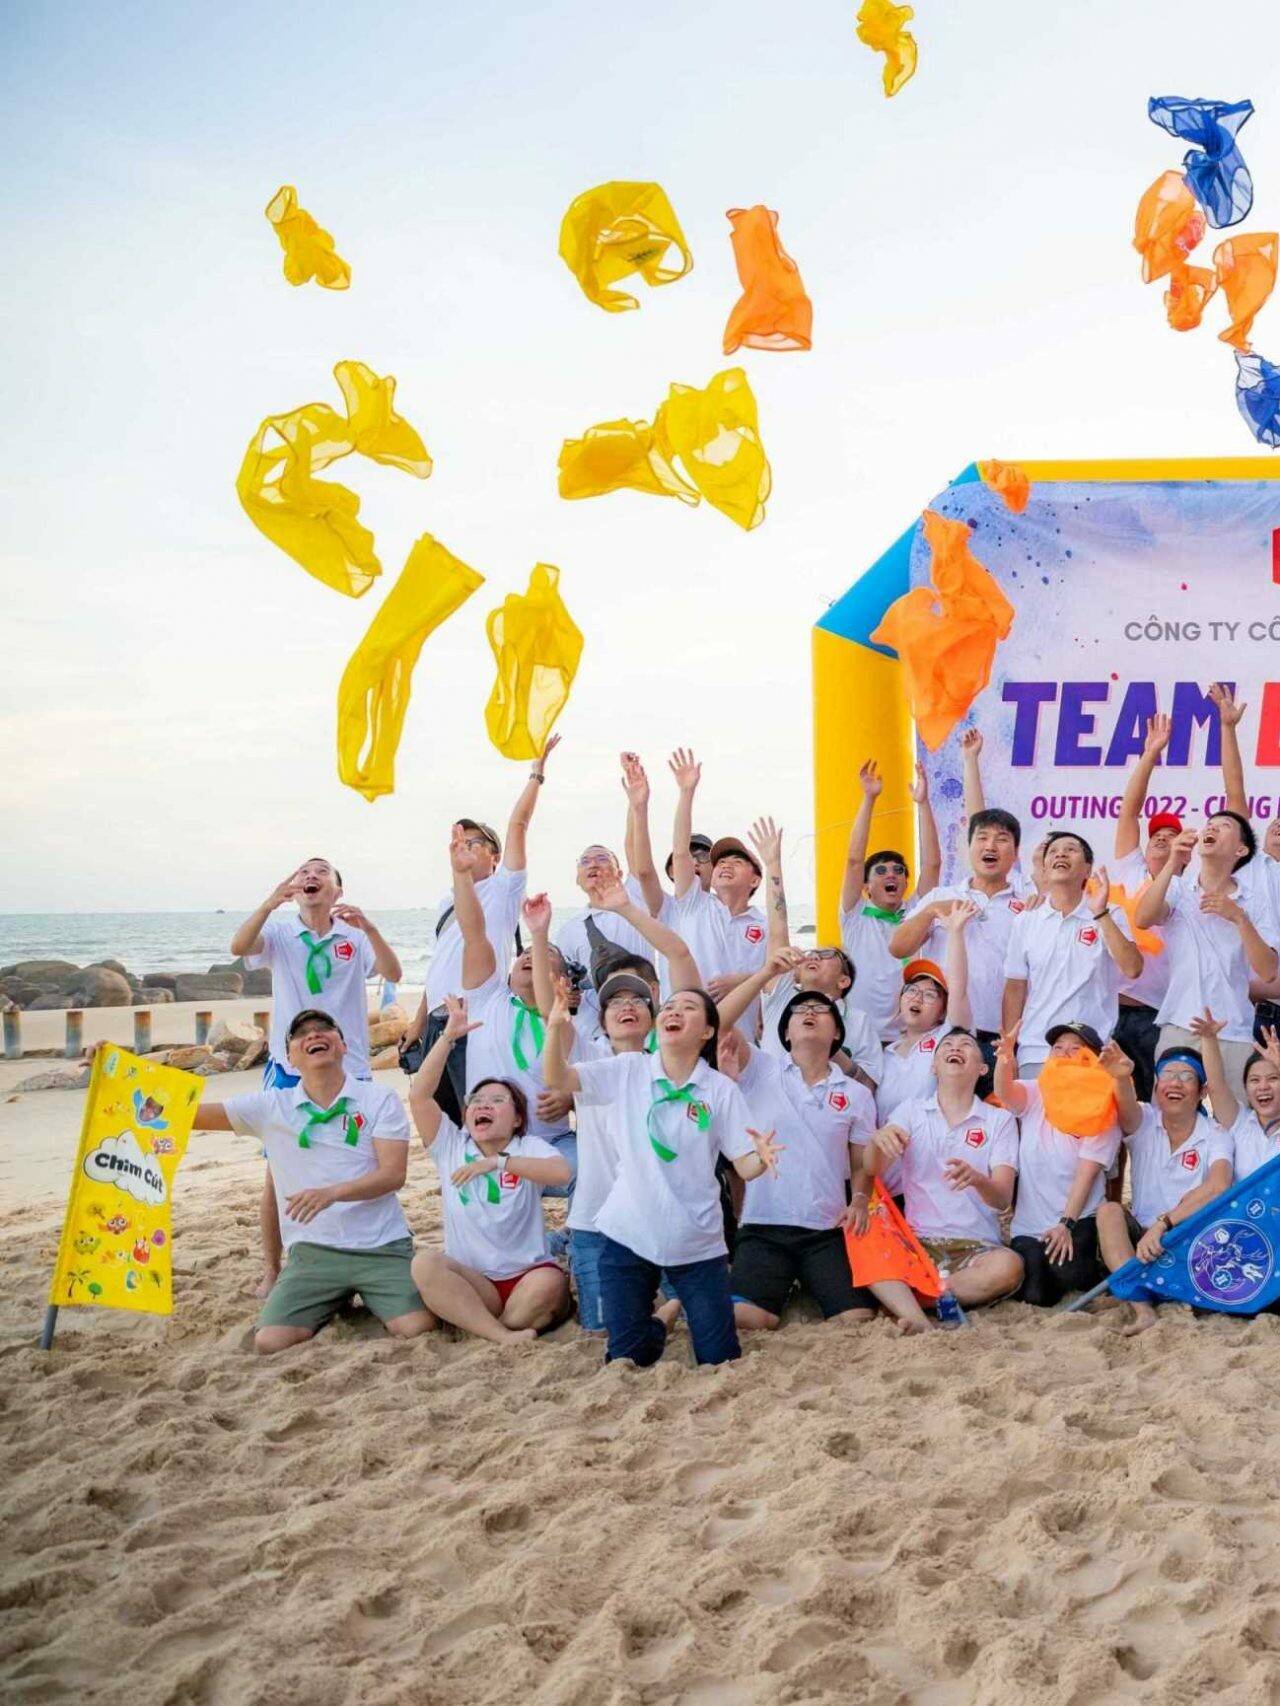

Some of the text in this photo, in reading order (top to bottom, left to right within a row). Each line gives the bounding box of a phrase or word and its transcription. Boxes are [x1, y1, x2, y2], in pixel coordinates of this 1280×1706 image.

[1124, 614, 1201, 642] CÔNG
[1208, 621, 1240, 642] TY
[1001, 681, 1237, 768] TEAM
[1031, 795, 1123, 819] OUTING
[1134, 795, 1187, 819] 022
[94, 1152, 164, 1194] Chim Cút
